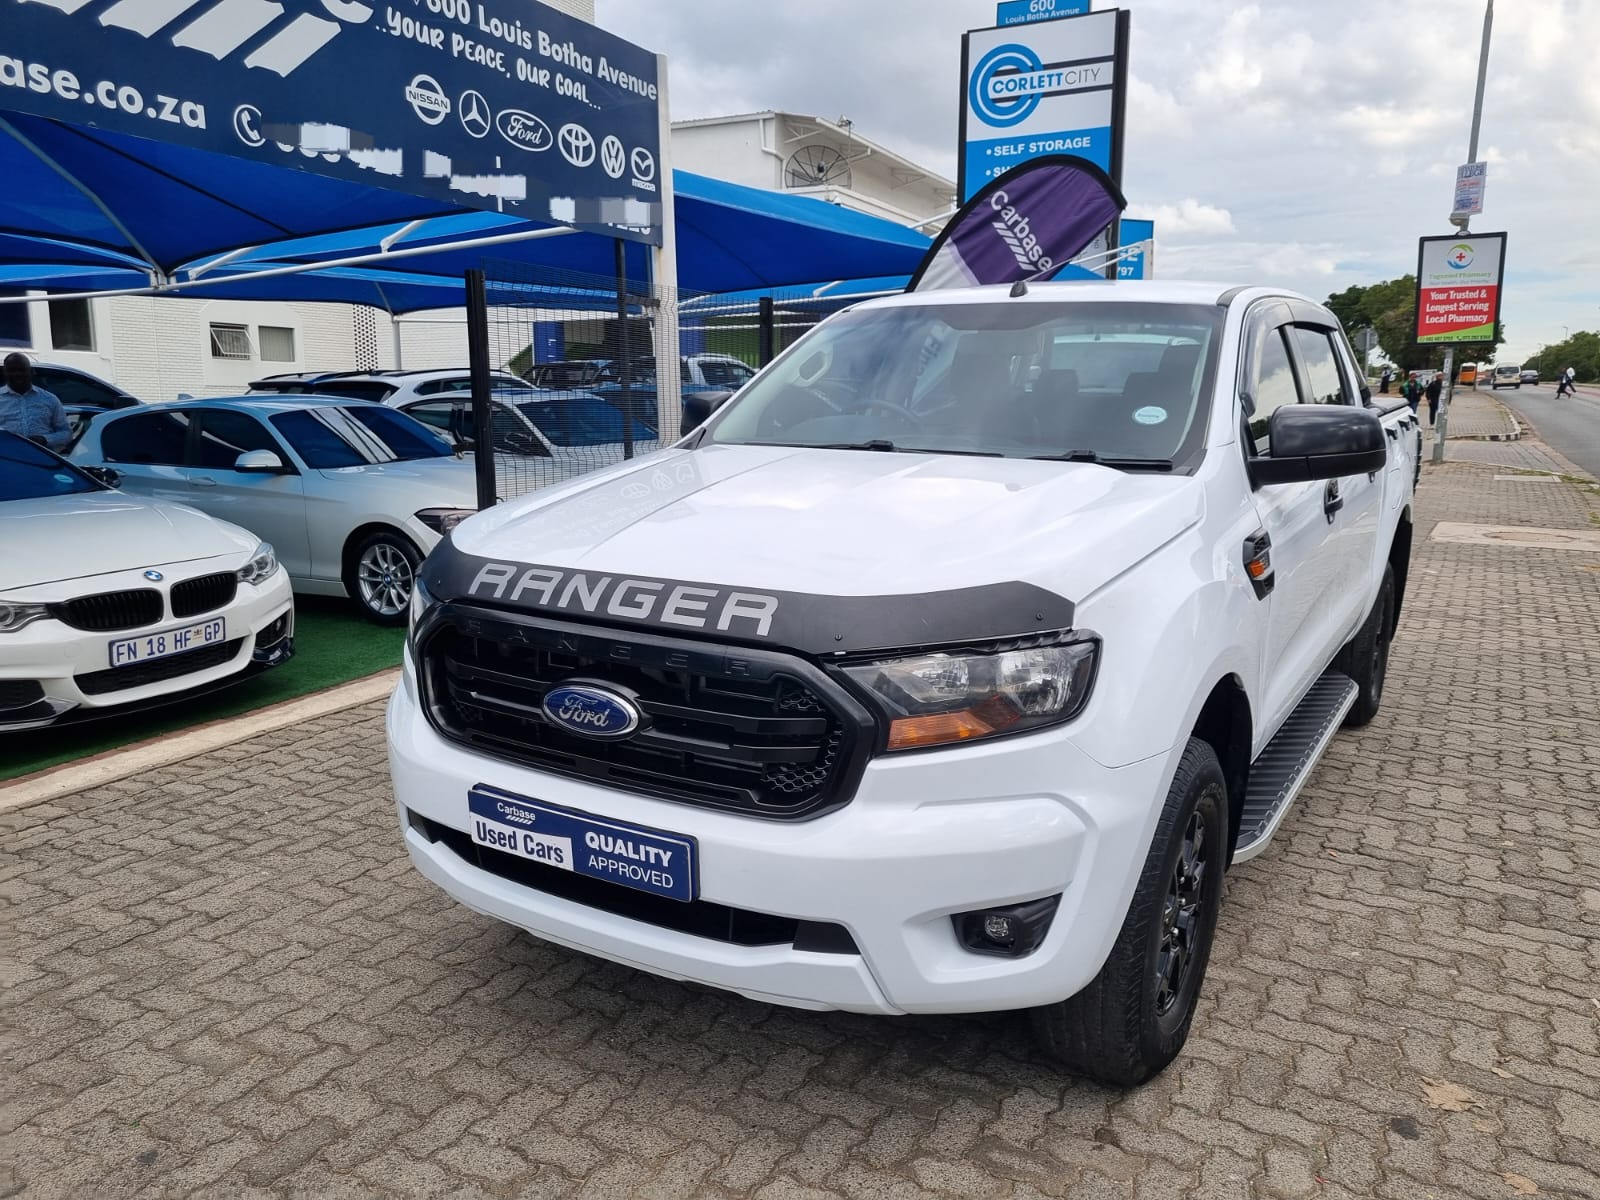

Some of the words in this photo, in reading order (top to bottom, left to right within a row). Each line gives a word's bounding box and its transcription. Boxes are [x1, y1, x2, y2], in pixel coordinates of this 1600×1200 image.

[1005, 16, 1025, 24] Louis
[1027, 12, 1049, 21] Botha
[1050, 7, 1080, 17] Avenue
[1029, 0, 1055, 13] 600
[478, 5, 533, 50] Louis
[538, 30, 593, 74] Botha
[597, 63, 658, 100] Avenue
[517, 58, 550, 89] OUR
[409, 90, 448, 109] NISSAN
[507, 114, 542, 146] Ford
[993, 143, 1025, 157] SELF
[1029, 136, 1091, 154] STORAGE
[991, 190, 1053, 273] Carbase
[1426, 302, 1458, 313] Longest
[1459, 301, 1490, 312] Serving
[1430, 291, 1448, 300] Your
[1449, 289, 1479, 299] Trusted
[1480, 289, 1487, 298] &
[1425, 315, 1447, 324] Local
[1448, 313, 1488, 324] Pharmacy
[467, 562, 779, 637] RANGER
[116, 641, 137, 663] FN
[146, 636, 166, 656] 18
[174, 629, 193, 651] HF
[204, 622, 221, 642] GP
[558, 694, 611, 728] Ford
[496, 802, 536, 821] Carbase
[476, 821, 518, 851] Used
[523, 834, 564, 864] Cars
[585, 831, 673, 867] QUALITY
[588, 855, 674, 889] APPROVED
